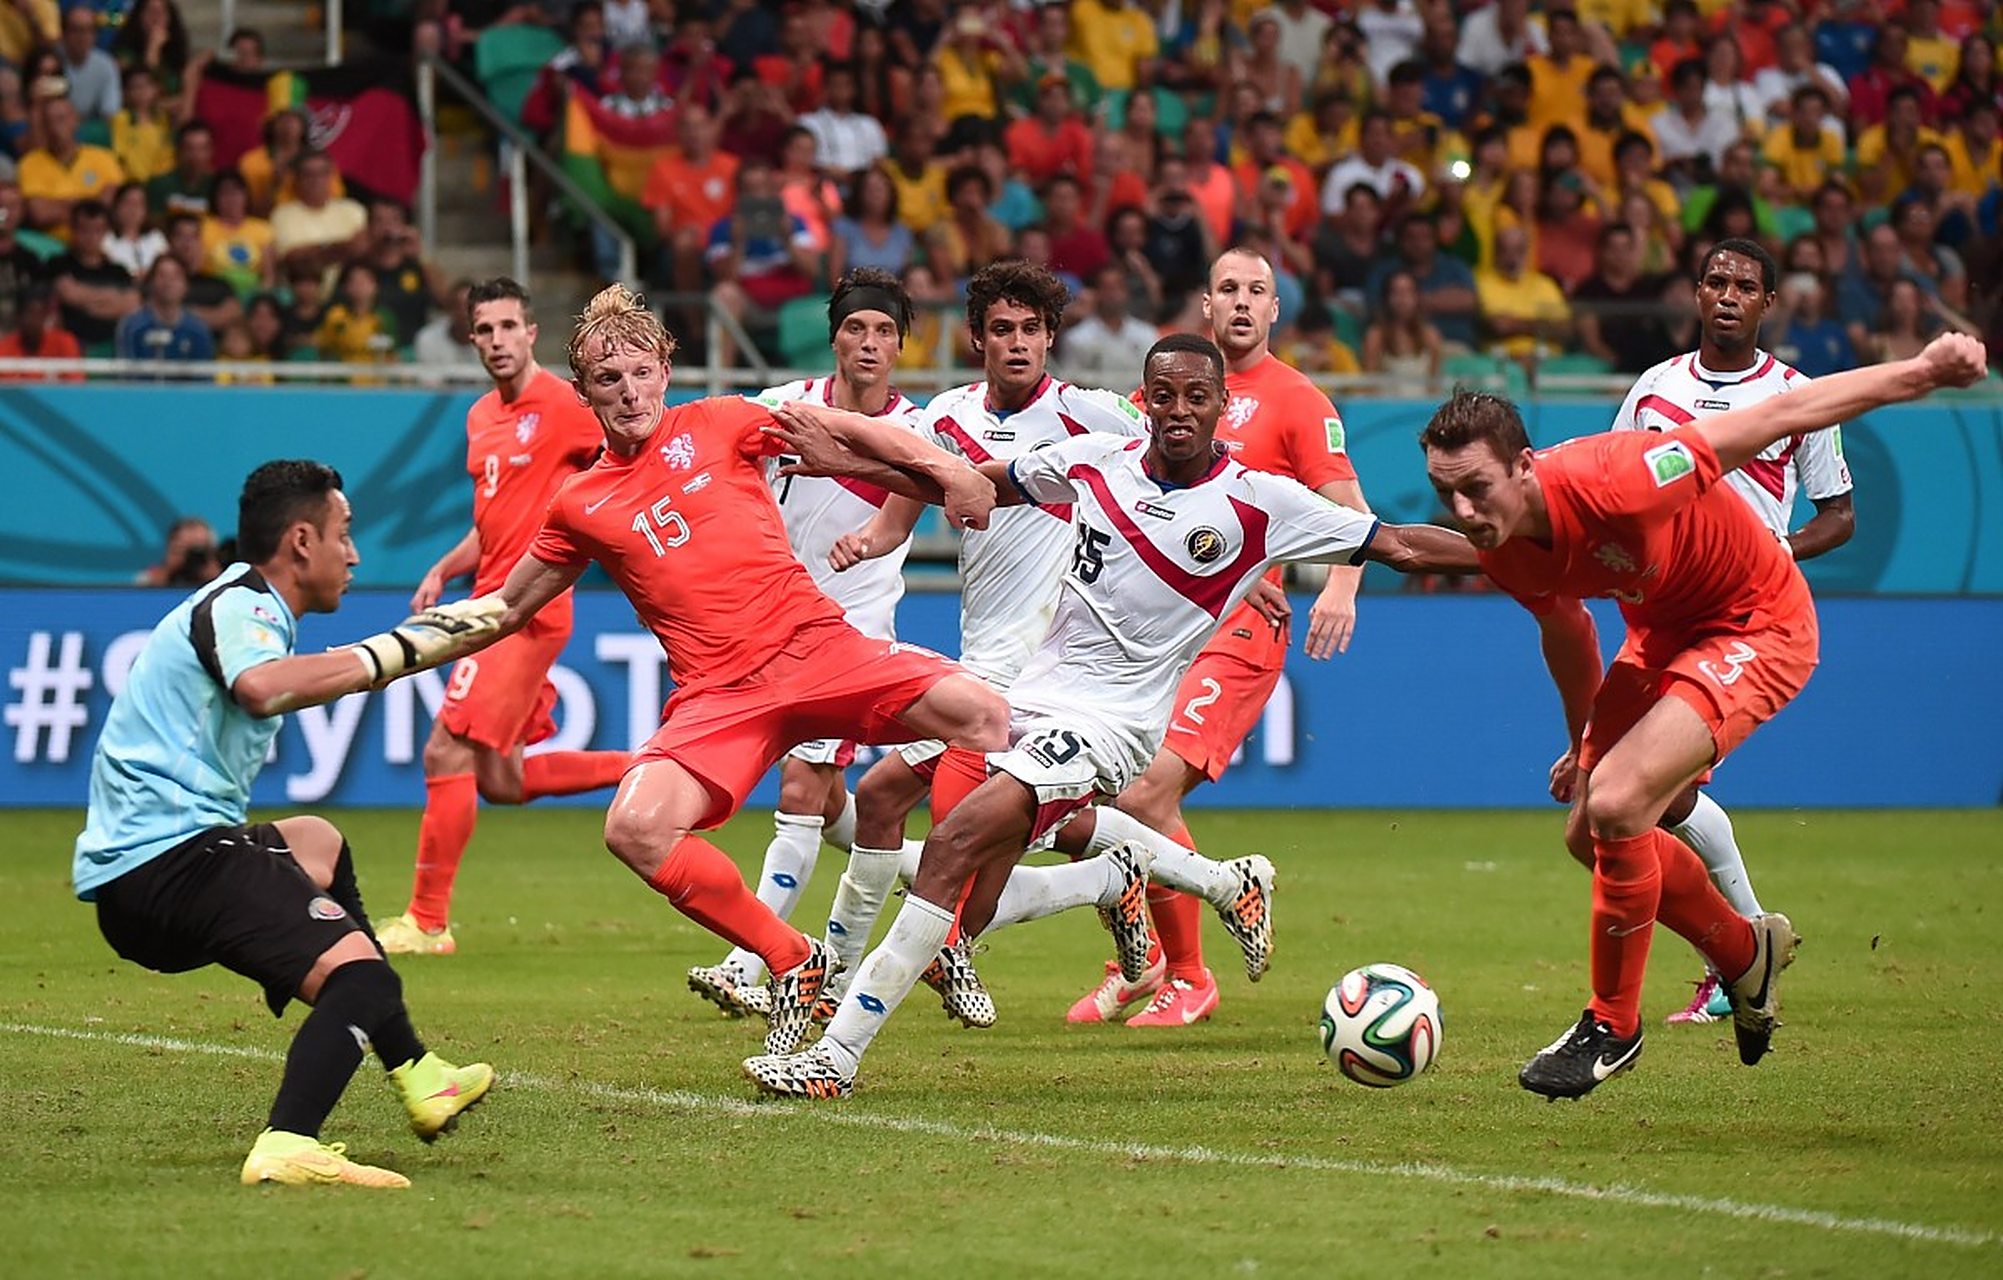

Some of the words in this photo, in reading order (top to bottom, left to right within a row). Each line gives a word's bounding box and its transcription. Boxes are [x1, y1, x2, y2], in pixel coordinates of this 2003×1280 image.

[484, 455, 498, 497] 9
[631, 496, 691, 557] 15
[447, 657, 479, 701] 9
[1723, 641, 1757, 686] 3
[1183, 677, 1222, 725] 2
